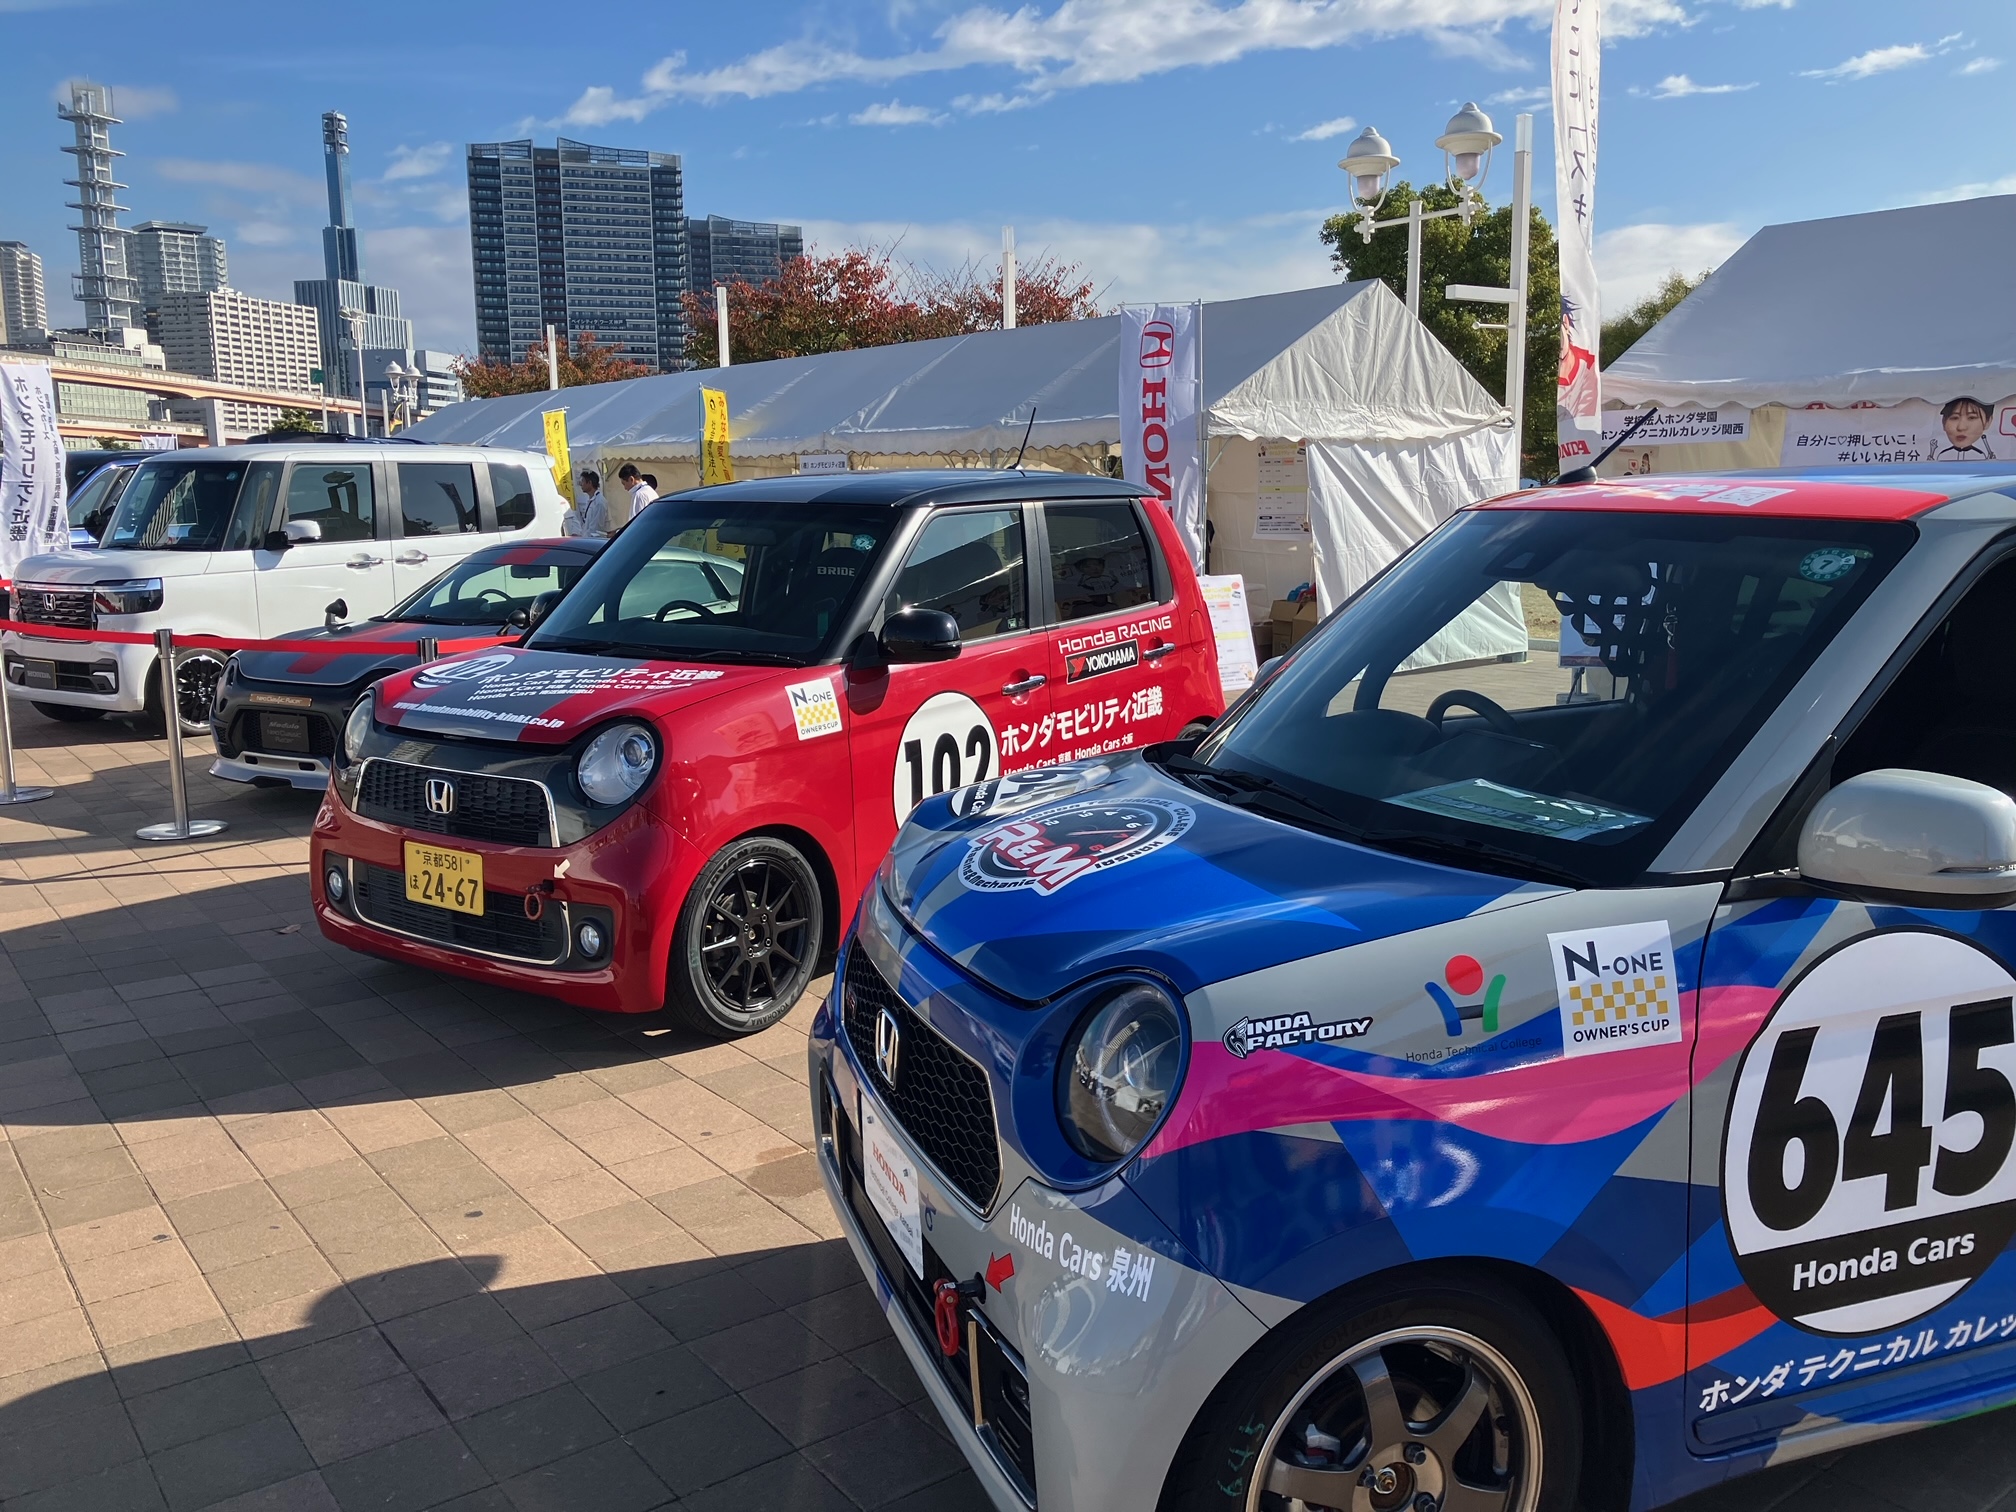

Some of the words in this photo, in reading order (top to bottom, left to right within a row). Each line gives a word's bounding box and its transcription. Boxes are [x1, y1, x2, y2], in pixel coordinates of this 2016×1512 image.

[817, 565, 856, 577] BRIDE
[1818, 559, 1834, 571] 7
[1058, 630, 1117, 655] Honda
[1117, 615, 1172, 641] RACING
[1085, 646, 1136, 673] YOKOHAMA
[474, 687, 514, 695] Honda
[477, 668, 725, 685] ホンダモビリティ近畿
[481, 681, 521, 690] Honda
[467, 693, 507, 702] Honda
[790, 688, 833, 707] N-ONE
[800, 724, 828, 735] OWNER'S
[826, 720, 839, 729] CUP
[1000, 685, 1164, 757] ホンダモビリティ近畿
[903, 723, 991, 806] 102
[1035, 752, 1057, 771] Cars
[1074, 742, 1103, 760] Honda
[1103, 737, 1121, 753] Cars
[1121, 732, 1134, 746] 大阪
[1165, 807, 1191, 838] COLLEGE
[1094, 840, 1165, 869] KANSAI
[410, 874, 420, 890] ほ
[421, 869, 479, 910] 24-67
[1561, 940, 1664, 982] N-ONE
[1246, 1019, 1371, 1051] FACTORY
[1573, 1023, 1640, 1043] OWNER'S
[1640, 1018, 1671, 1034] CUP
[1405, 1048, 1443, 1063] Honda
[1445, 1040, 1498, 1057] Technical
[1499, 1035, 1543, 1051] College
[1747, 995, 2016, 1232] 645
[872, 1141, 908, 1204] HONDA
[1009, 1202, 1054, 1261] Honda
[1059, 1232, 1104, 1282] Cars
[1106, 1246, 1156, 1303] 泉州
[1793, 1246, 1898, 1292] Honda
[1907, 1231, 1976, 1266] Cars
[1699, 1360, 1794, 1413] ホンダ
[1798, 1329, 1940, 1387] テクニカル
